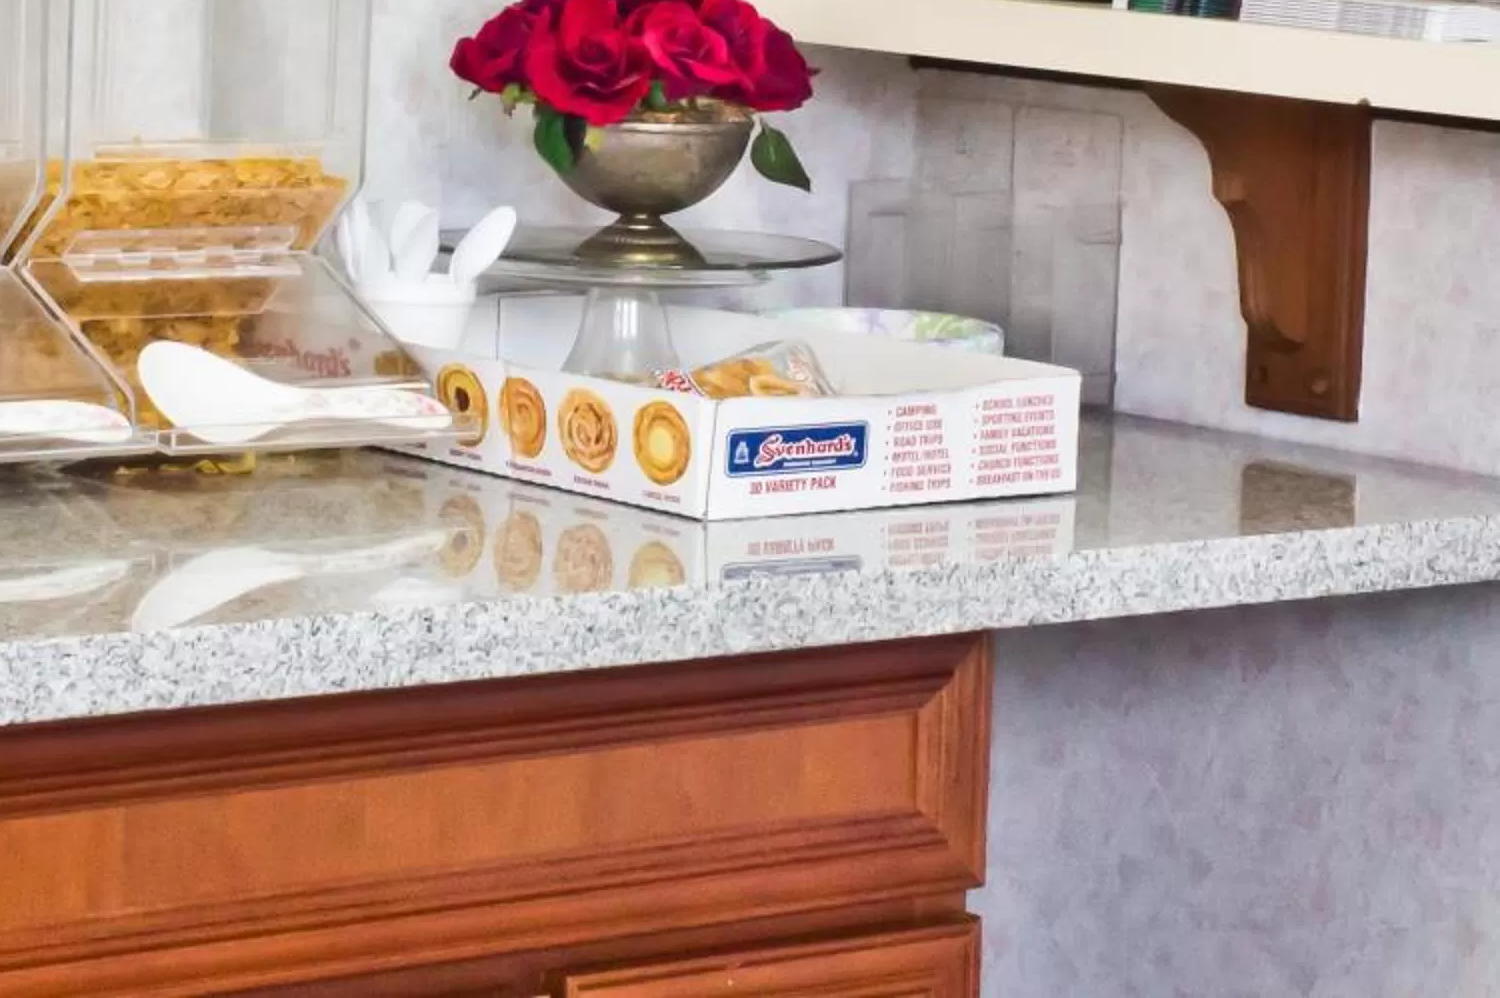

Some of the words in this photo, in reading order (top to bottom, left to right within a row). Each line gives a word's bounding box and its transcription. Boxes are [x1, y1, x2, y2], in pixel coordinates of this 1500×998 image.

[754, 433, 854, 468] Svenhard's
[765, 478, 808, 493] VARIETY
[810, 476, 836, 490] PACK
